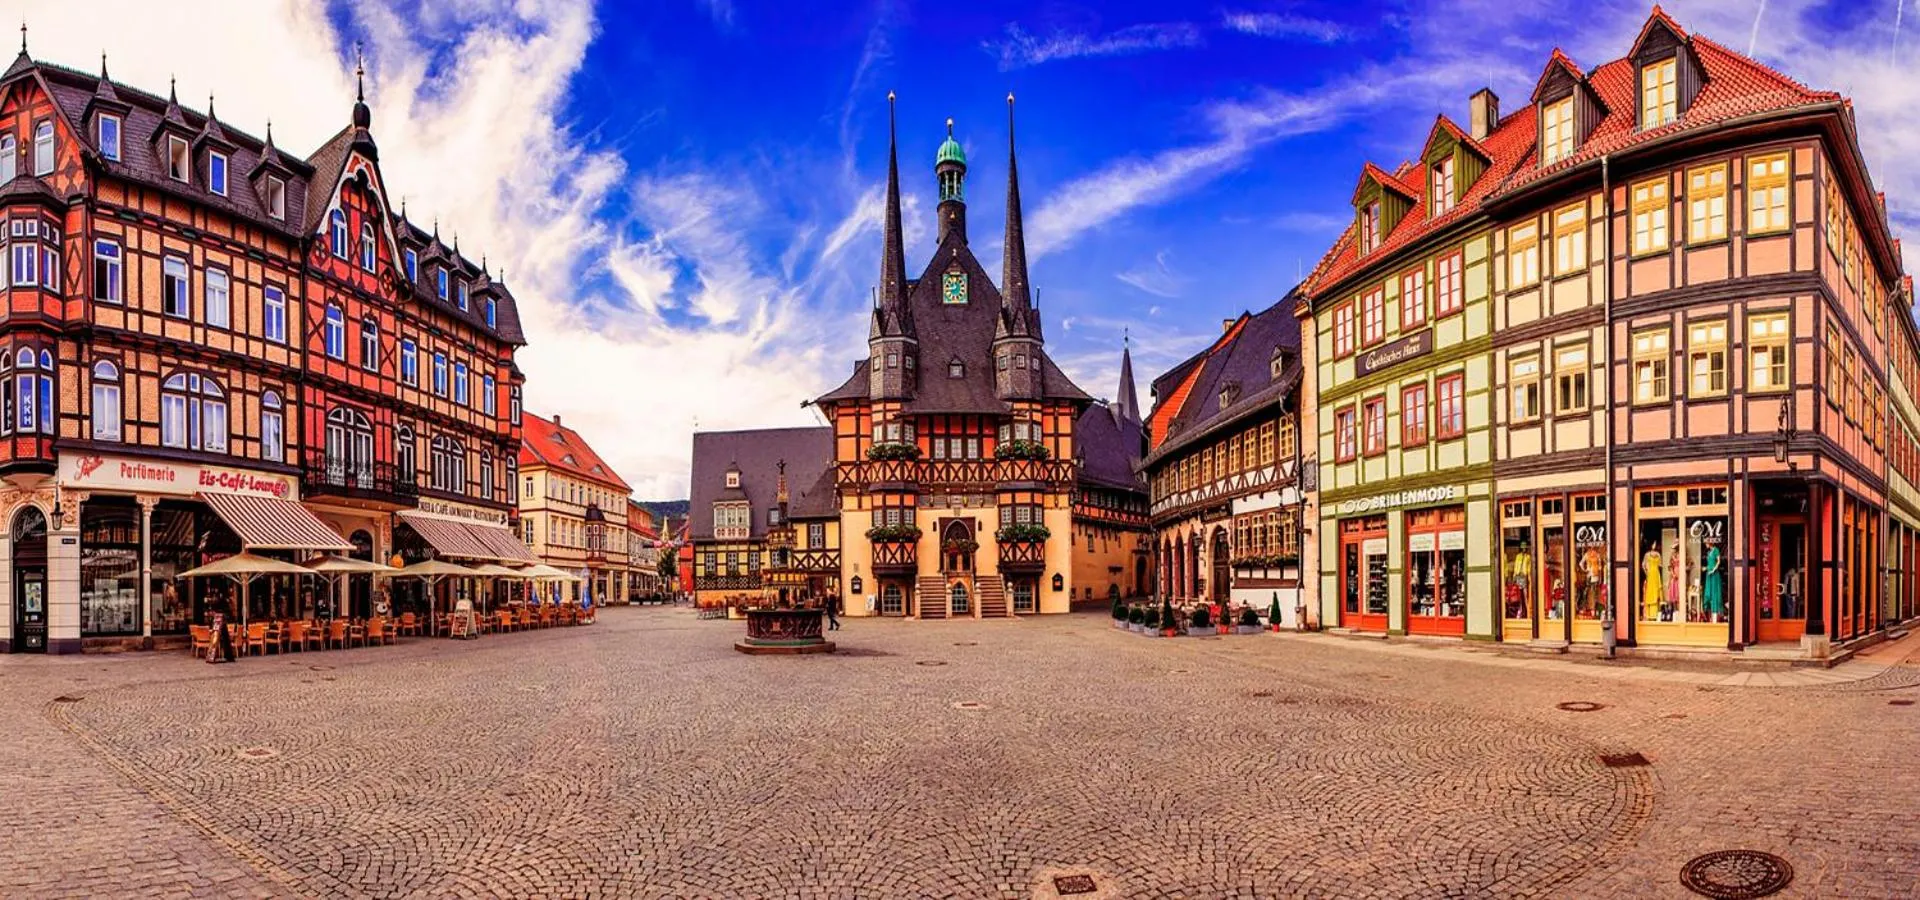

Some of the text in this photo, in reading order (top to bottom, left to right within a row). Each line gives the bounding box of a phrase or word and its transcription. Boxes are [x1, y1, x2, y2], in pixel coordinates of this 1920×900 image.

[120, 462, 175, 482] Parfümerie
[199, 470, 286, 497] Eis-Café-Lounge
[1373, 485, 1455, 508] BRILLENMODE
